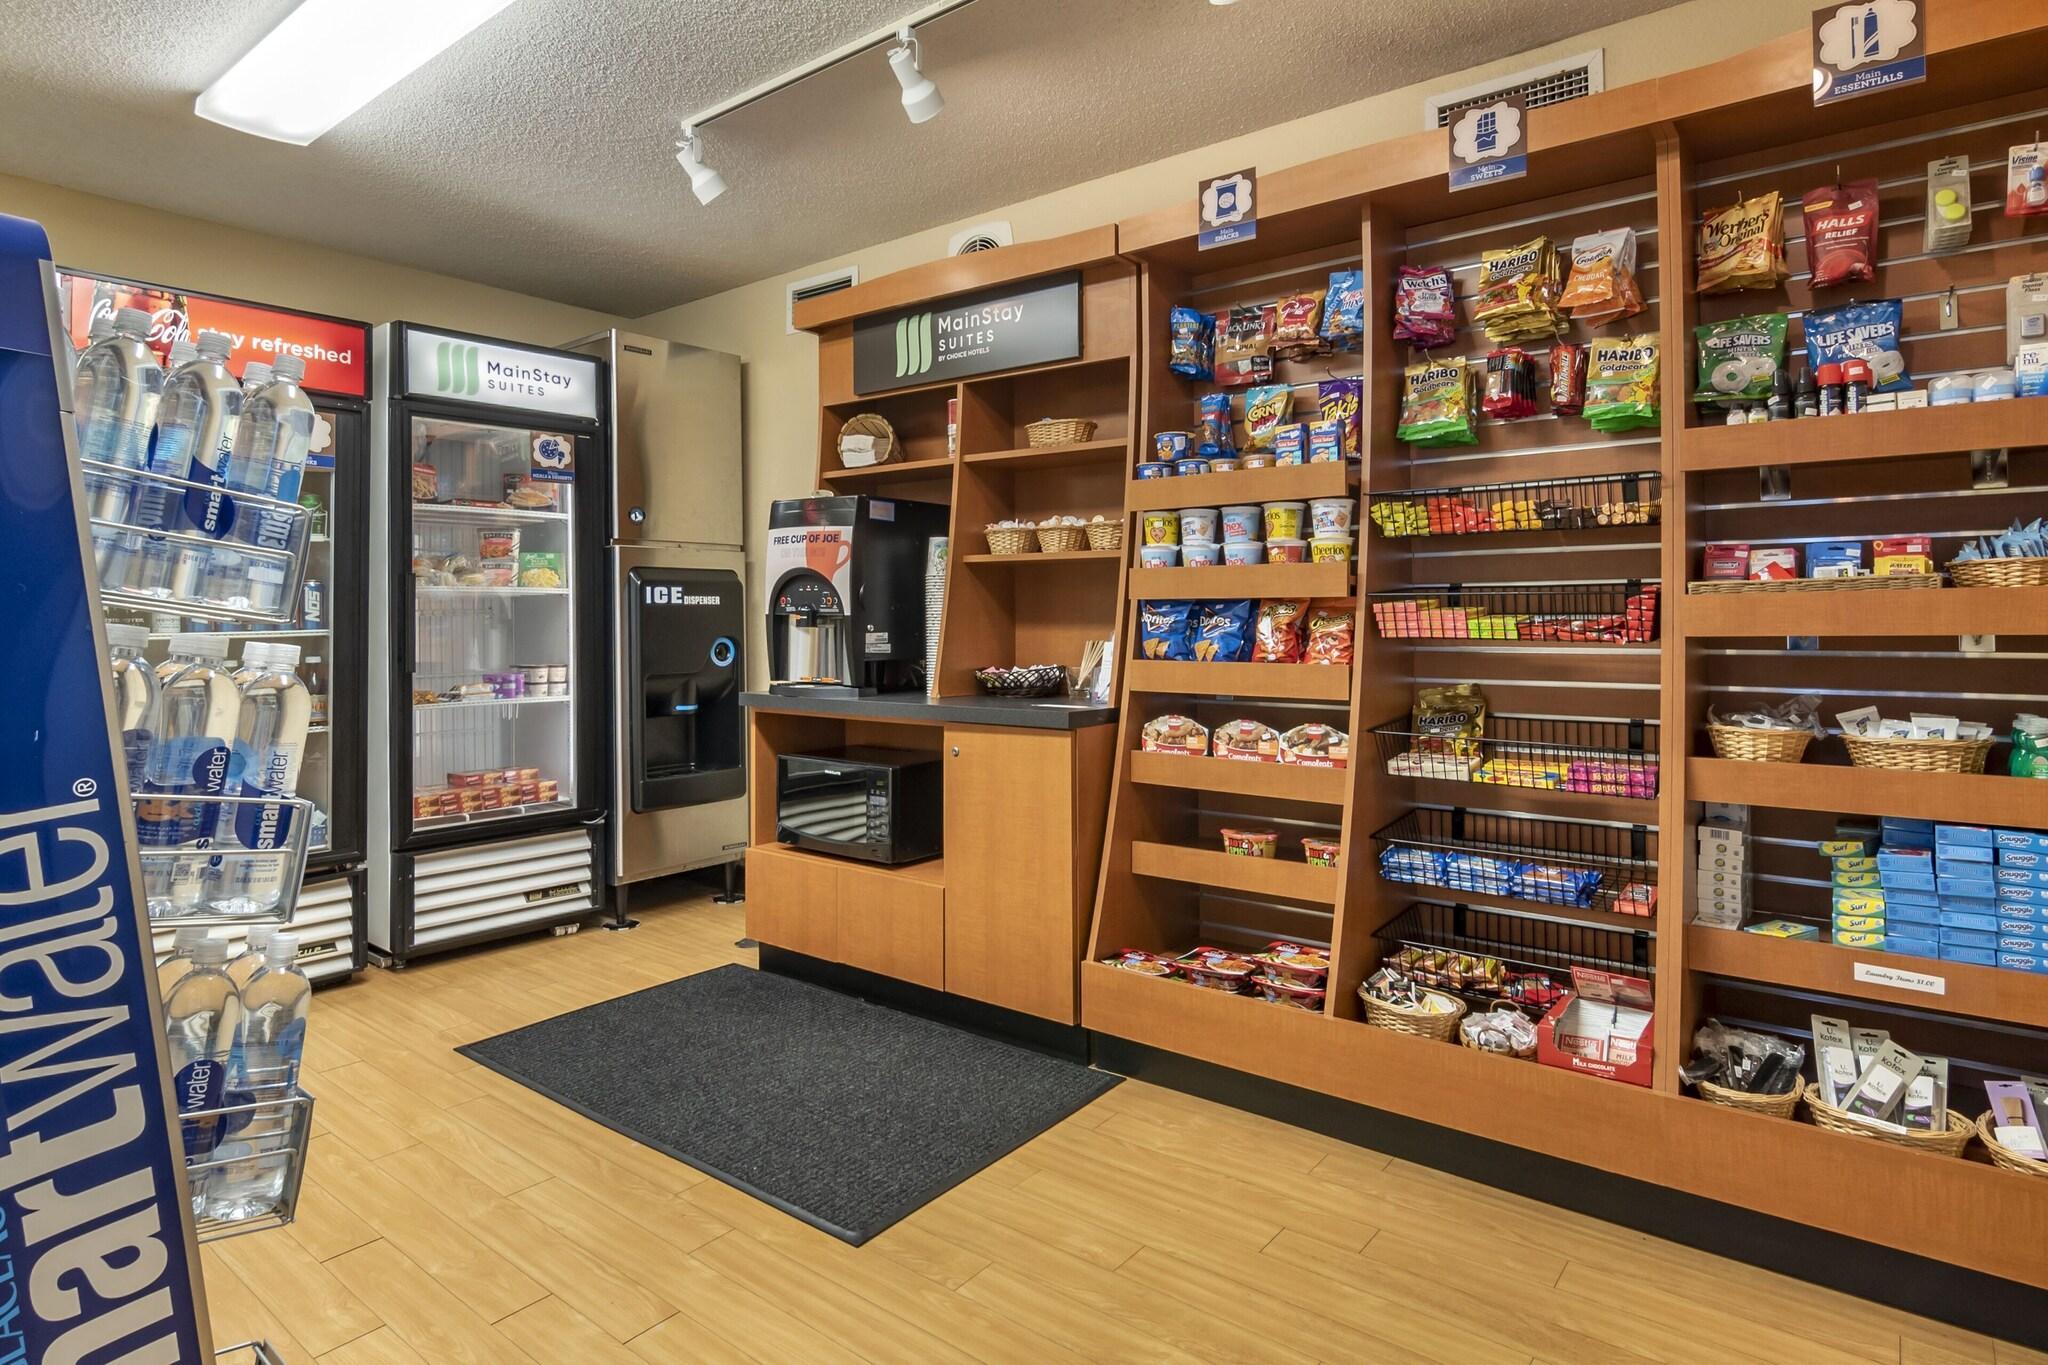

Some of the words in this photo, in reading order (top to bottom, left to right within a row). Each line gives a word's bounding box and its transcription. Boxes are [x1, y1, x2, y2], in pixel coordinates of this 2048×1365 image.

[1855, 69, 1881, 82] Main
[1834, 71, 1904, 95] ESSENTIALS
[1470, 169, 1504, 181] SWEETS
[1706, 208, 1770, 237] Werther's
[1815, 214, 1865, 231] HALLS
[1719, 223, 1765, 248] Original
[1825, 228, 1858, 240] RELIEF
[1489, 250, 1538, 272] HARIBO
[1490, 265, 1534, 281] Goldbears
[1406, 275, 1447, 288] Welch's
[938, 304, 1024, 334] MainStay
[938, 330, 995, 351] SUITES
[1733, 334, 1772, 346] SAVERS
[1817, 330, 1846, 347] LIFE
[1846, 322, 1895, 342] SAVERS
[252, 336, 353, 366] refreshed
[938, 353, 946, 362] BY
[946, 350, 967, 361] CHOICE
[968, 347, 990, 358] HOTELS
[1598, 347, 1653, 361] HARIBO
[487, 360, 572, 389] MainStay
[1410, 369, 1458, 385] HARIBO
[488, 380, 546, 396] SUITES
[1413, 381, 1455, 393] Goldbears
[1247, 402, 1276, 422] CORN
[1322, 399, 1359, 423] Takis
[773, 535, 790, 545] FREE
[791, 534, 807, 544] CUP
[808, 534, 821, 543] OF
[822, 533, 840, 543] JOE
[1313, 545, 1345, 556] Cheerios
[645, 586, 683, 605] ICE
[684, 595, 721, 605] DISPENSER
[303, 586, 321, 622] NOS
[1419, 714, 1466, 725] HARIBO
[206, 749, 227, 792] water
[1228, 838, 1242, 847] HOT
[1242, 840, 1248, 848] &
[1999, 835, 2030, 844] Snuggle
[1833, 843, 1848, 852] Surf
[1309, 848, 1323, 859] HOT
[1323, 852, 1330, 860] &
[2006, 854, 2037, 862] Snuggle
[1848, 860, 1865, 868] Surf
[1848, 875, 1865, 883] Surf
[1999, 870, 2031, 879] Snuggle
[2001, 887, 2032, 896] Snuggle
[1850, 902, 1867, 911] Surf
[2002, 905, 2033, 914] Snuggle
[1850, 919, 1867, 927] Surf
[2003, 922, 2034, 931] Snuggle
[1850, 934, 1867, 943] Surf
[2002, 939, 2033, 948] Snuggle
[2003, 956, 2034, 965] Snuggle
[1865, 970, 1893, 981] Laundry
[1820, 1034, 1843, 1043] kotex
[1881, 1056, 1907, 1076] kotex
[186, 1062, 211, 1109] water
